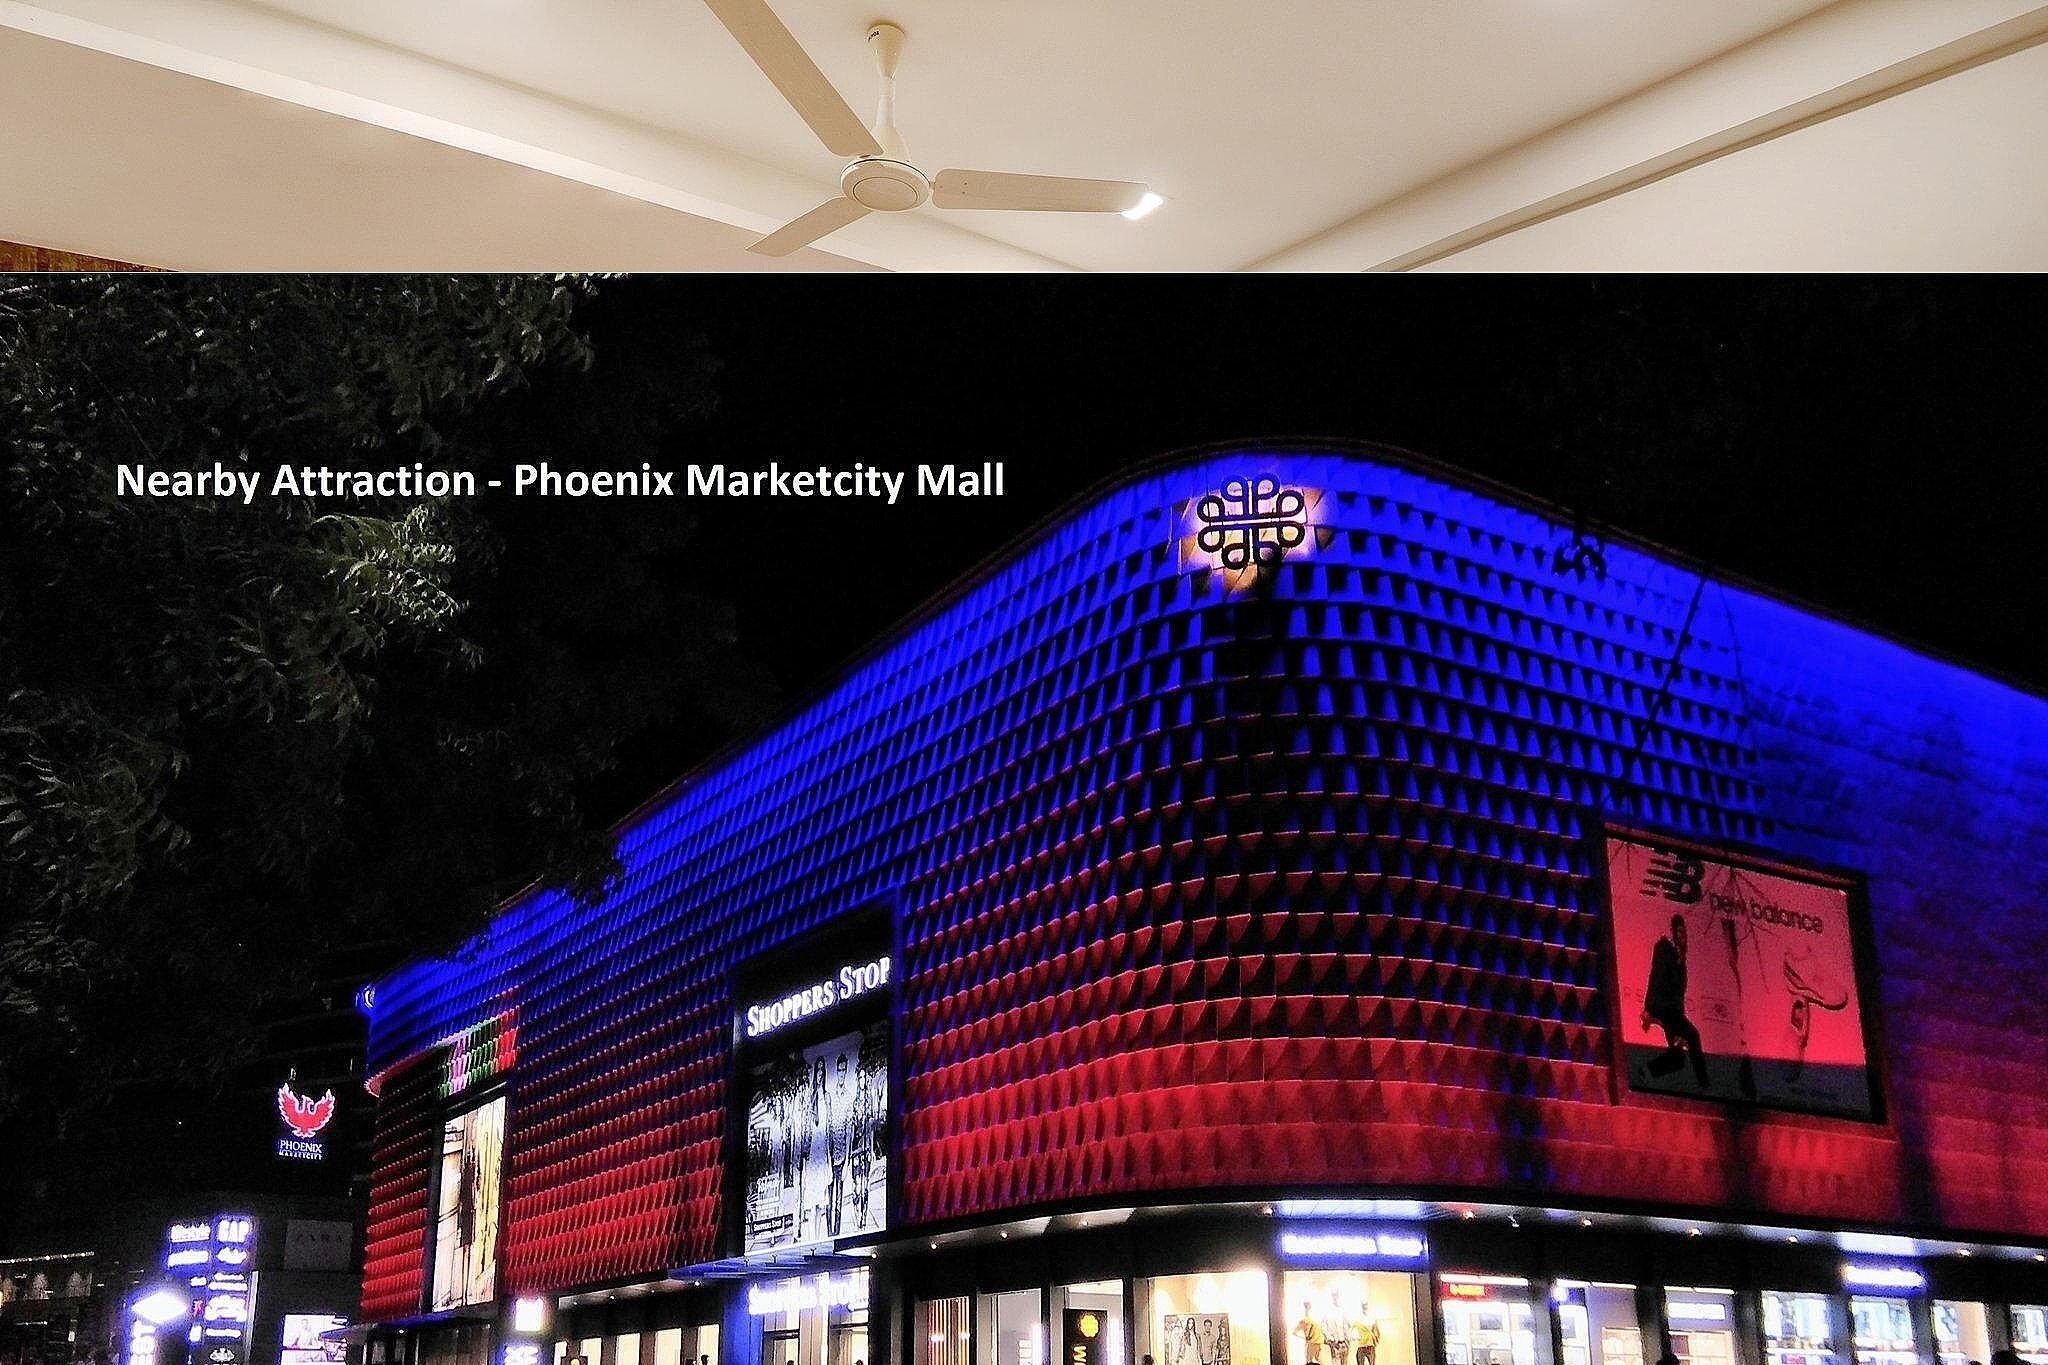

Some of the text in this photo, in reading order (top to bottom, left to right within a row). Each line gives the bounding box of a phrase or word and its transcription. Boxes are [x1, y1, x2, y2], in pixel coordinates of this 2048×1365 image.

[1710, 894, 1823, 934] new balance
[747, 957, 890, 1037] SHOPPERS STOP
[280, 1140, 322, 1153] PHOENIX
